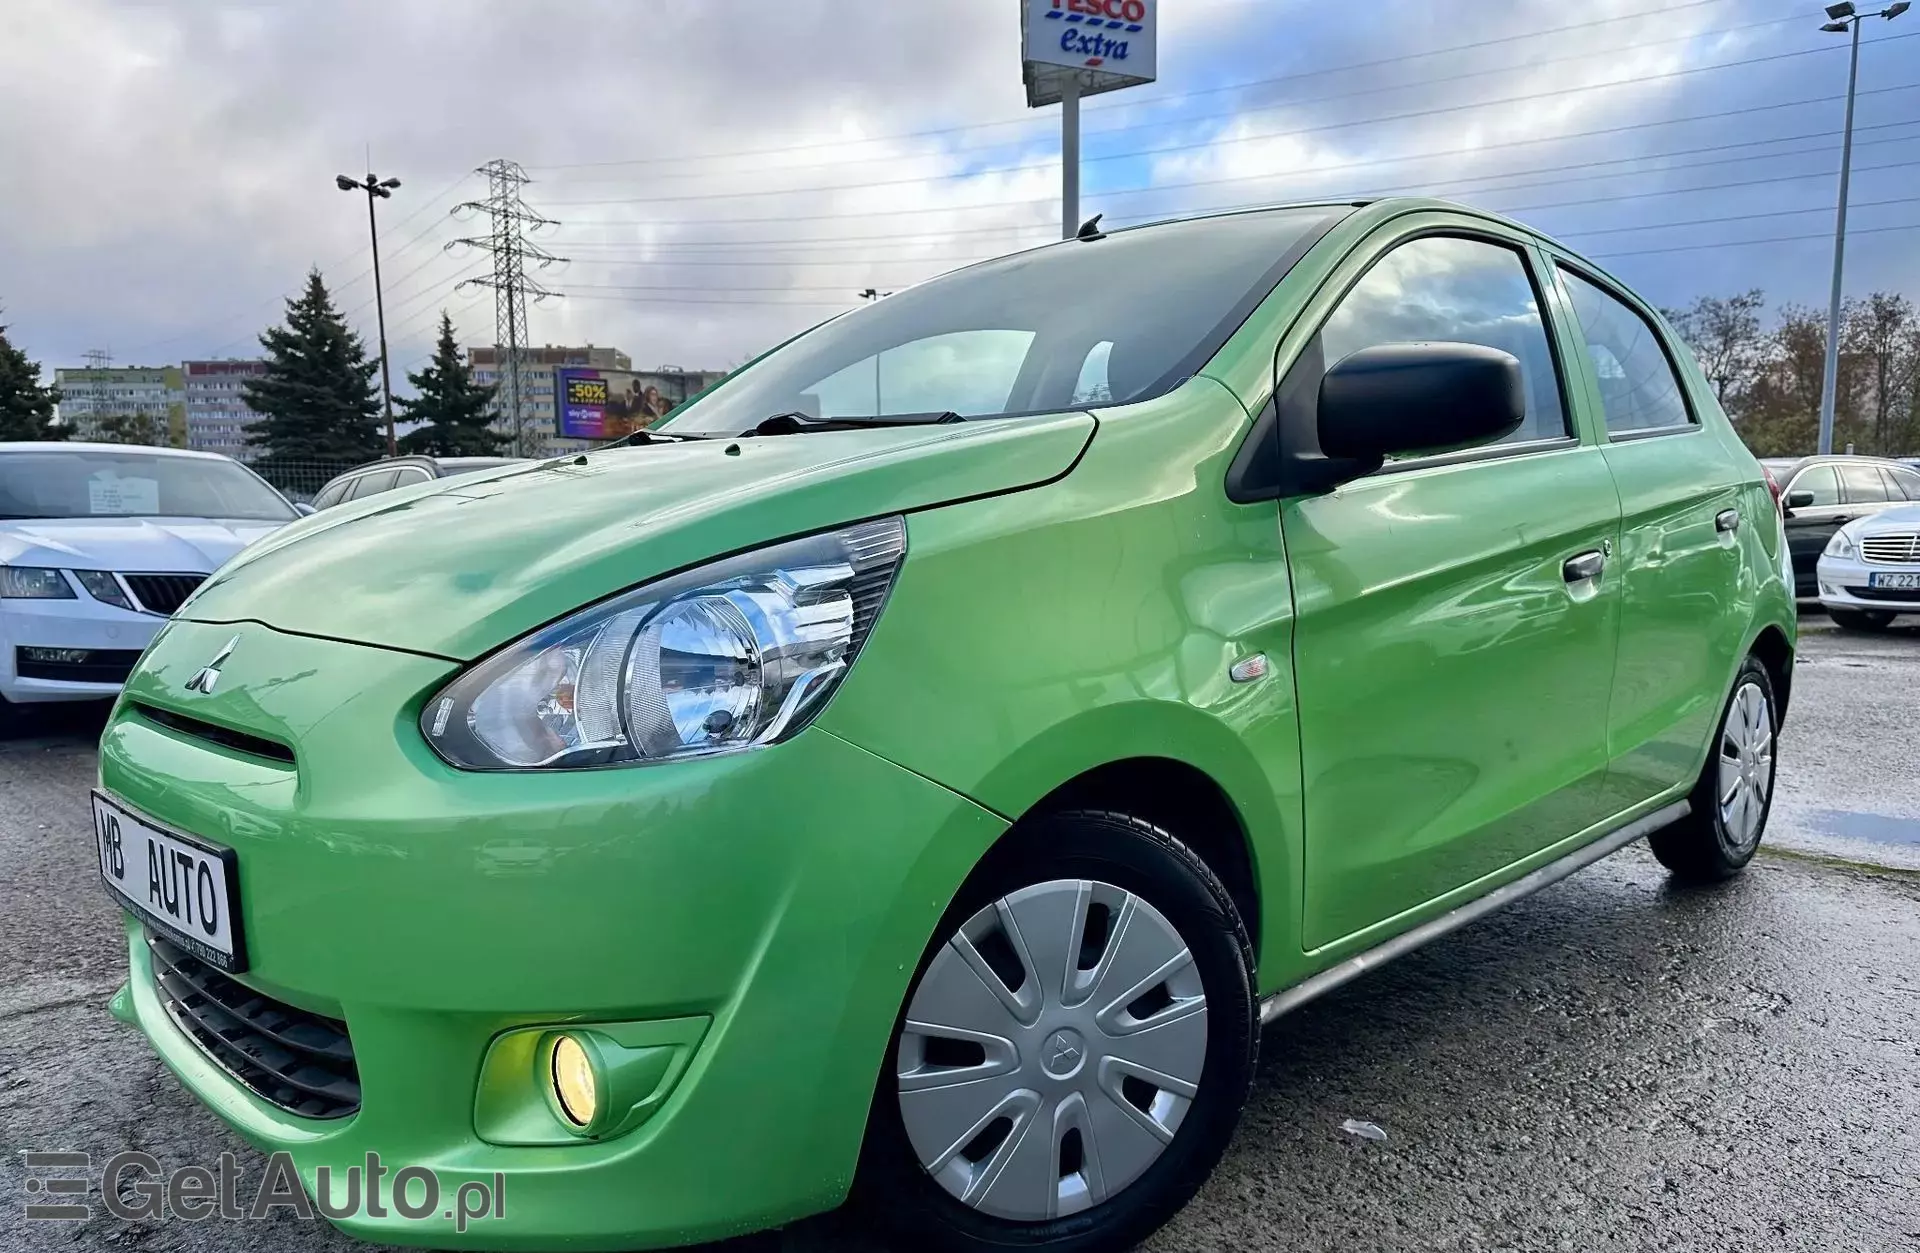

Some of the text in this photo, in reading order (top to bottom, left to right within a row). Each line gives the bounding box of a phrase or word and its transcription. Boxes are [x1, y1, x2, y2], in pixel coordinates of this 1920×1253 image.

[1060, 28, 1129, 60] extra
[568, 384, 606, 399] -50%
[1877, 574, 1894, 587] WZ
[100, 808, 125, 880] MB
[148, 838, 217, 936] AUTO
